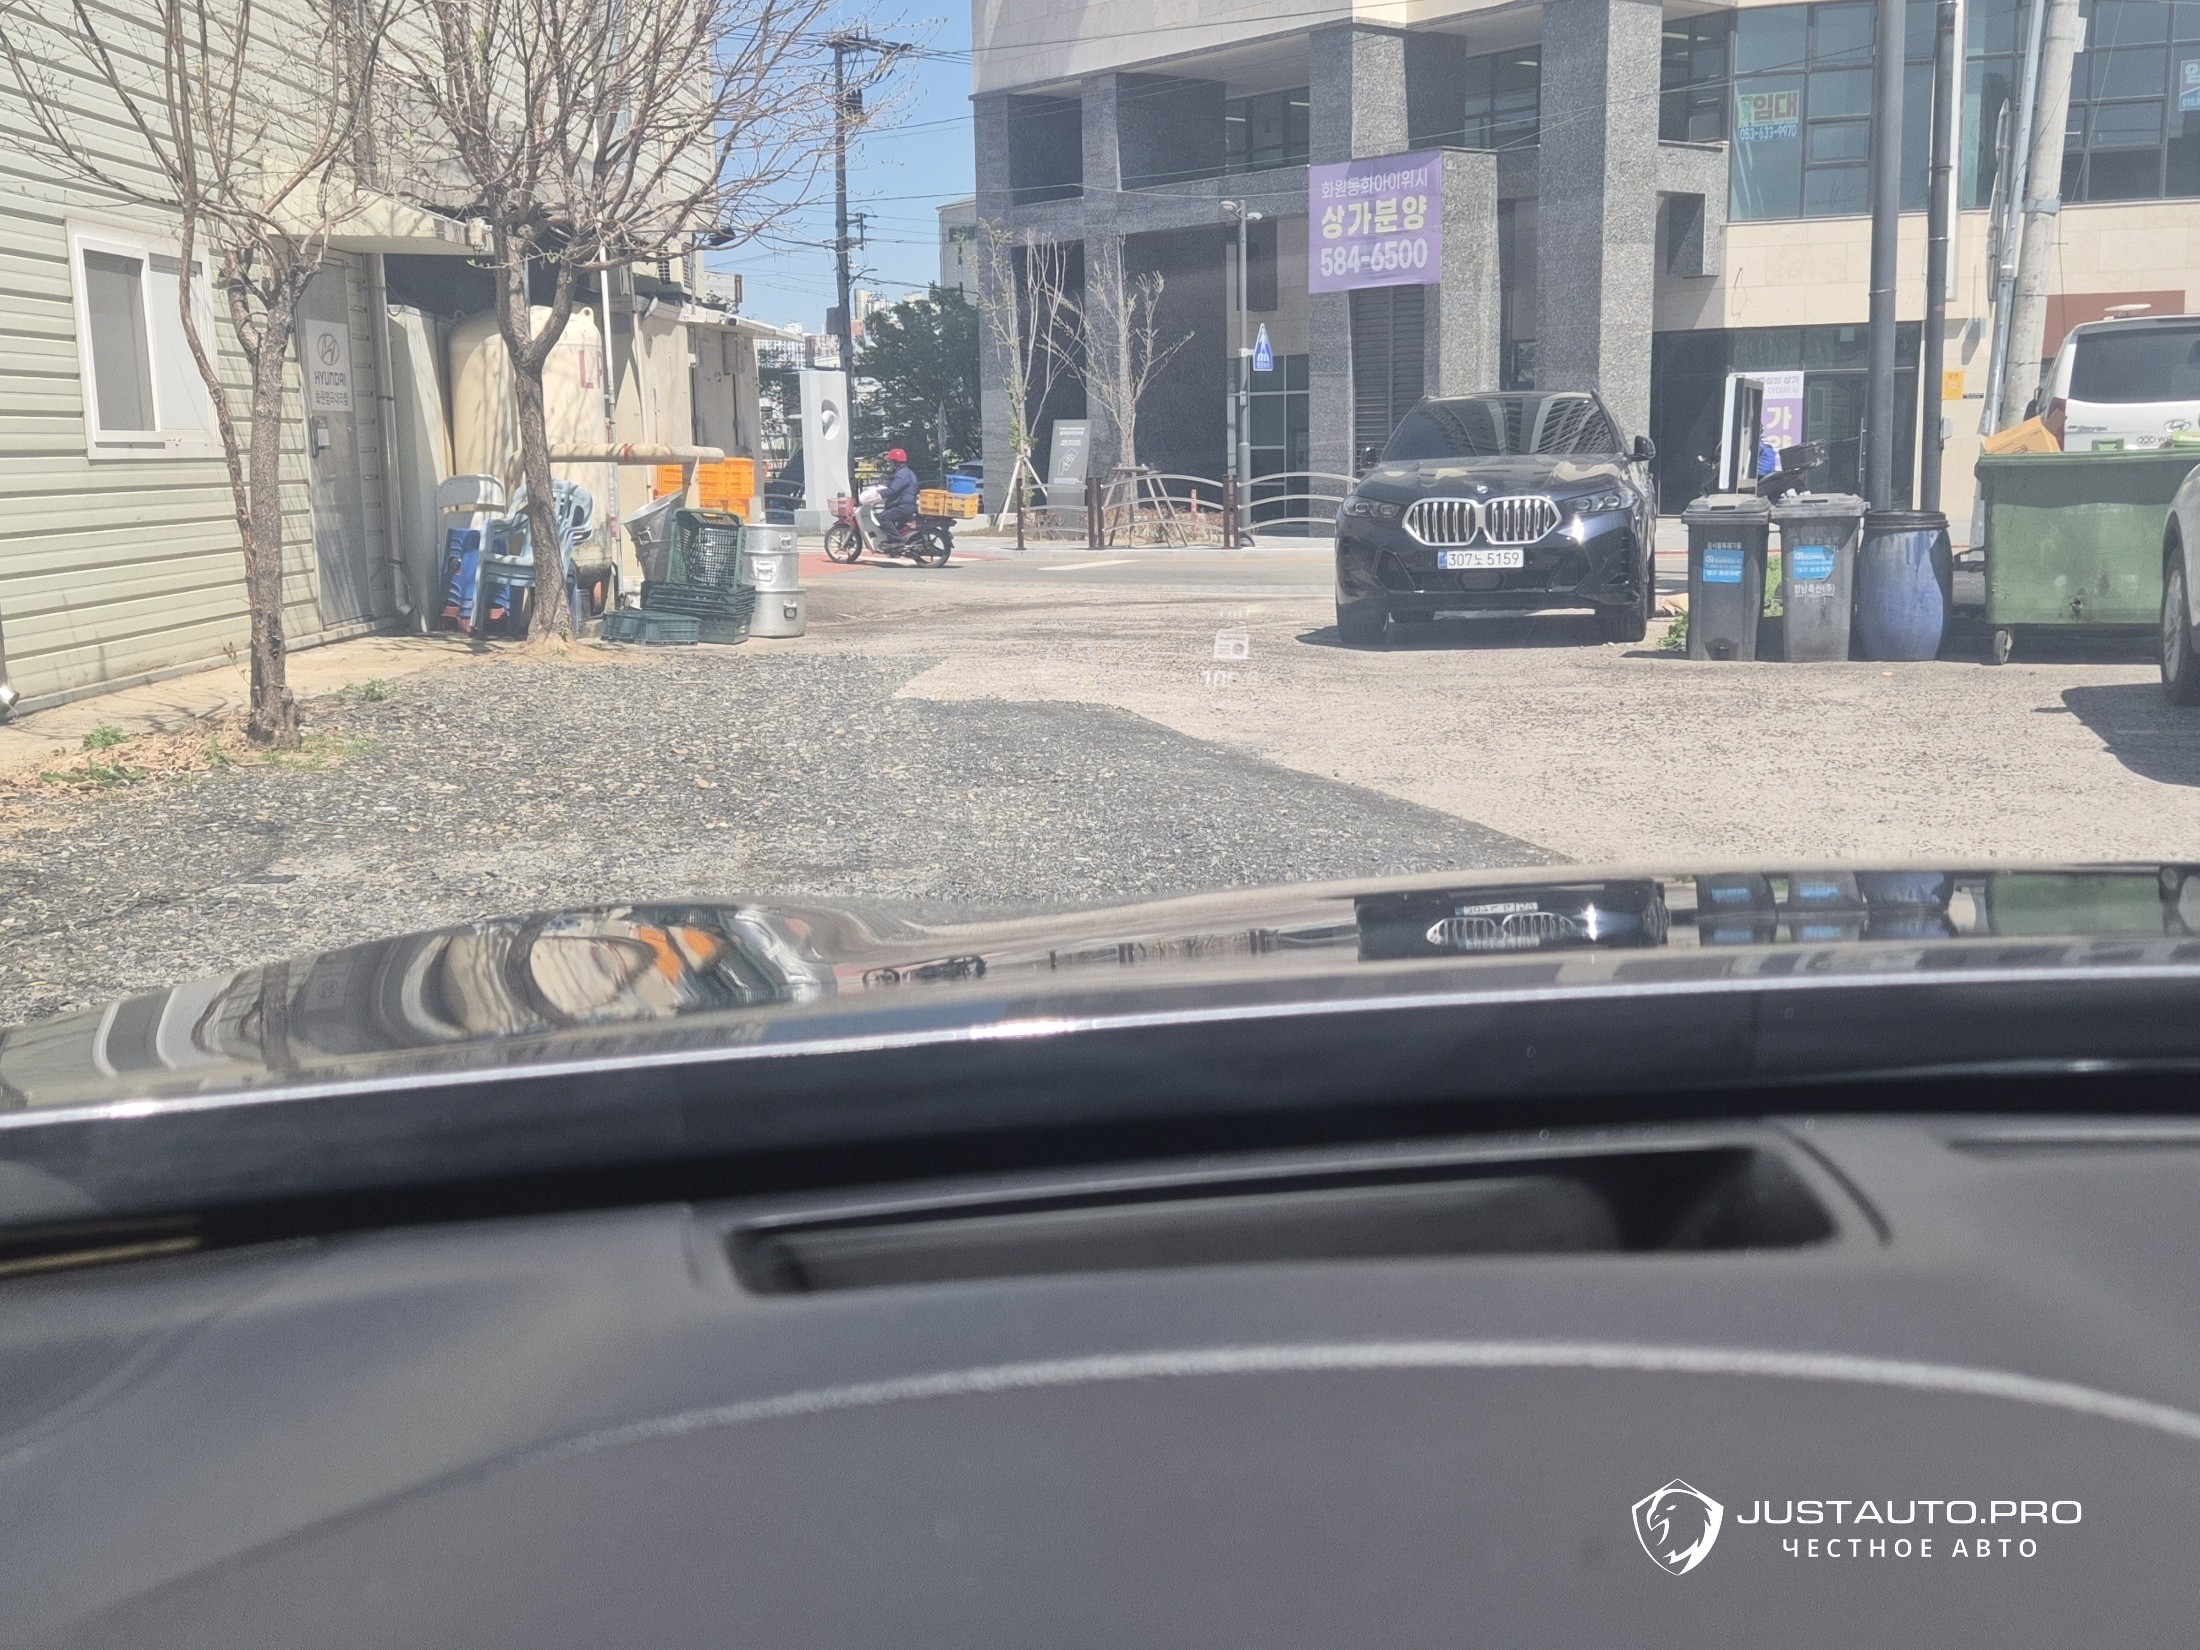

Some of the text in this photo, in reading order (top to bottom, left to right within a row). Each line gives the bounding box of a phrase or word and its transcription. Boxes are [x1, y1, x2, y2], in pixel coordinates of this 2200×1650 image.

[1753, 92, 1798, 121] 임대
[1321, 167, 1428, 199] 화원동화아이위시
[1321, 194, 1428, 239] 상가분양
[1320, 238, 1428, 277] 584-6500
[314, 370, 347, 387] HYUNDAI
[1766, 405, 1793, 430] 가
[1449, 551, 1520, 567] 307노 5159
